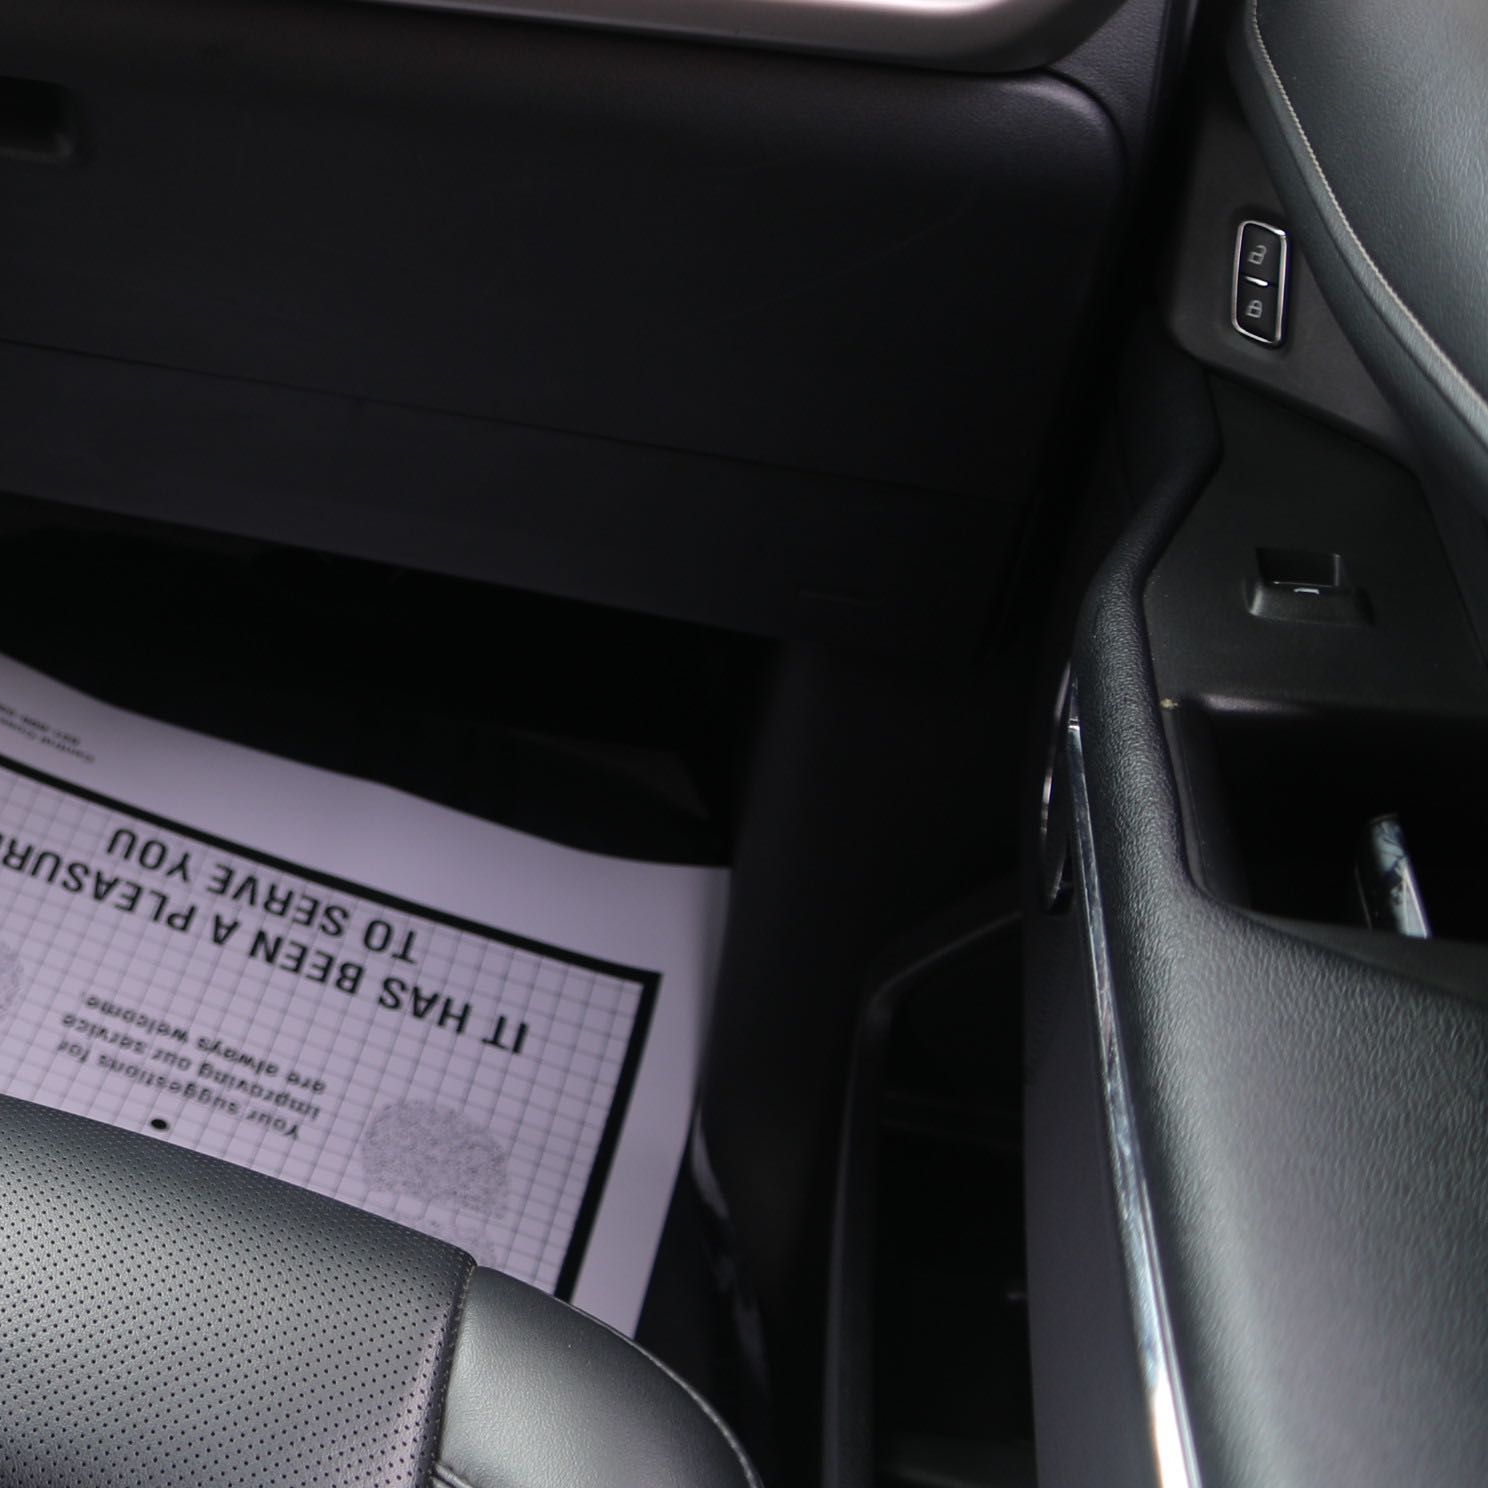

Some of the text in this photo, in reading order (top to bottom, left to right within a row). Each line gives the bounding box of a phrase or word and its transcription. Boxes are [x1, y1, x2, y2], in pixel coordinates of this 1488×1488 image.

[106, 827, 419, 965] TO SERVE YOU
[211, 913, 241, 946] A
[248, 928, 368, 996] BEEN
[377, 977, 473, 1035] HAS
[481, 1014, 530, 1055] IT
[61, 1013, 321, 1121] improving our service
[195, 1035, 281, 1078] always
[285, 1071, 328, 1095] are
[57, 1039, 301, 1140] Your suggestions for
